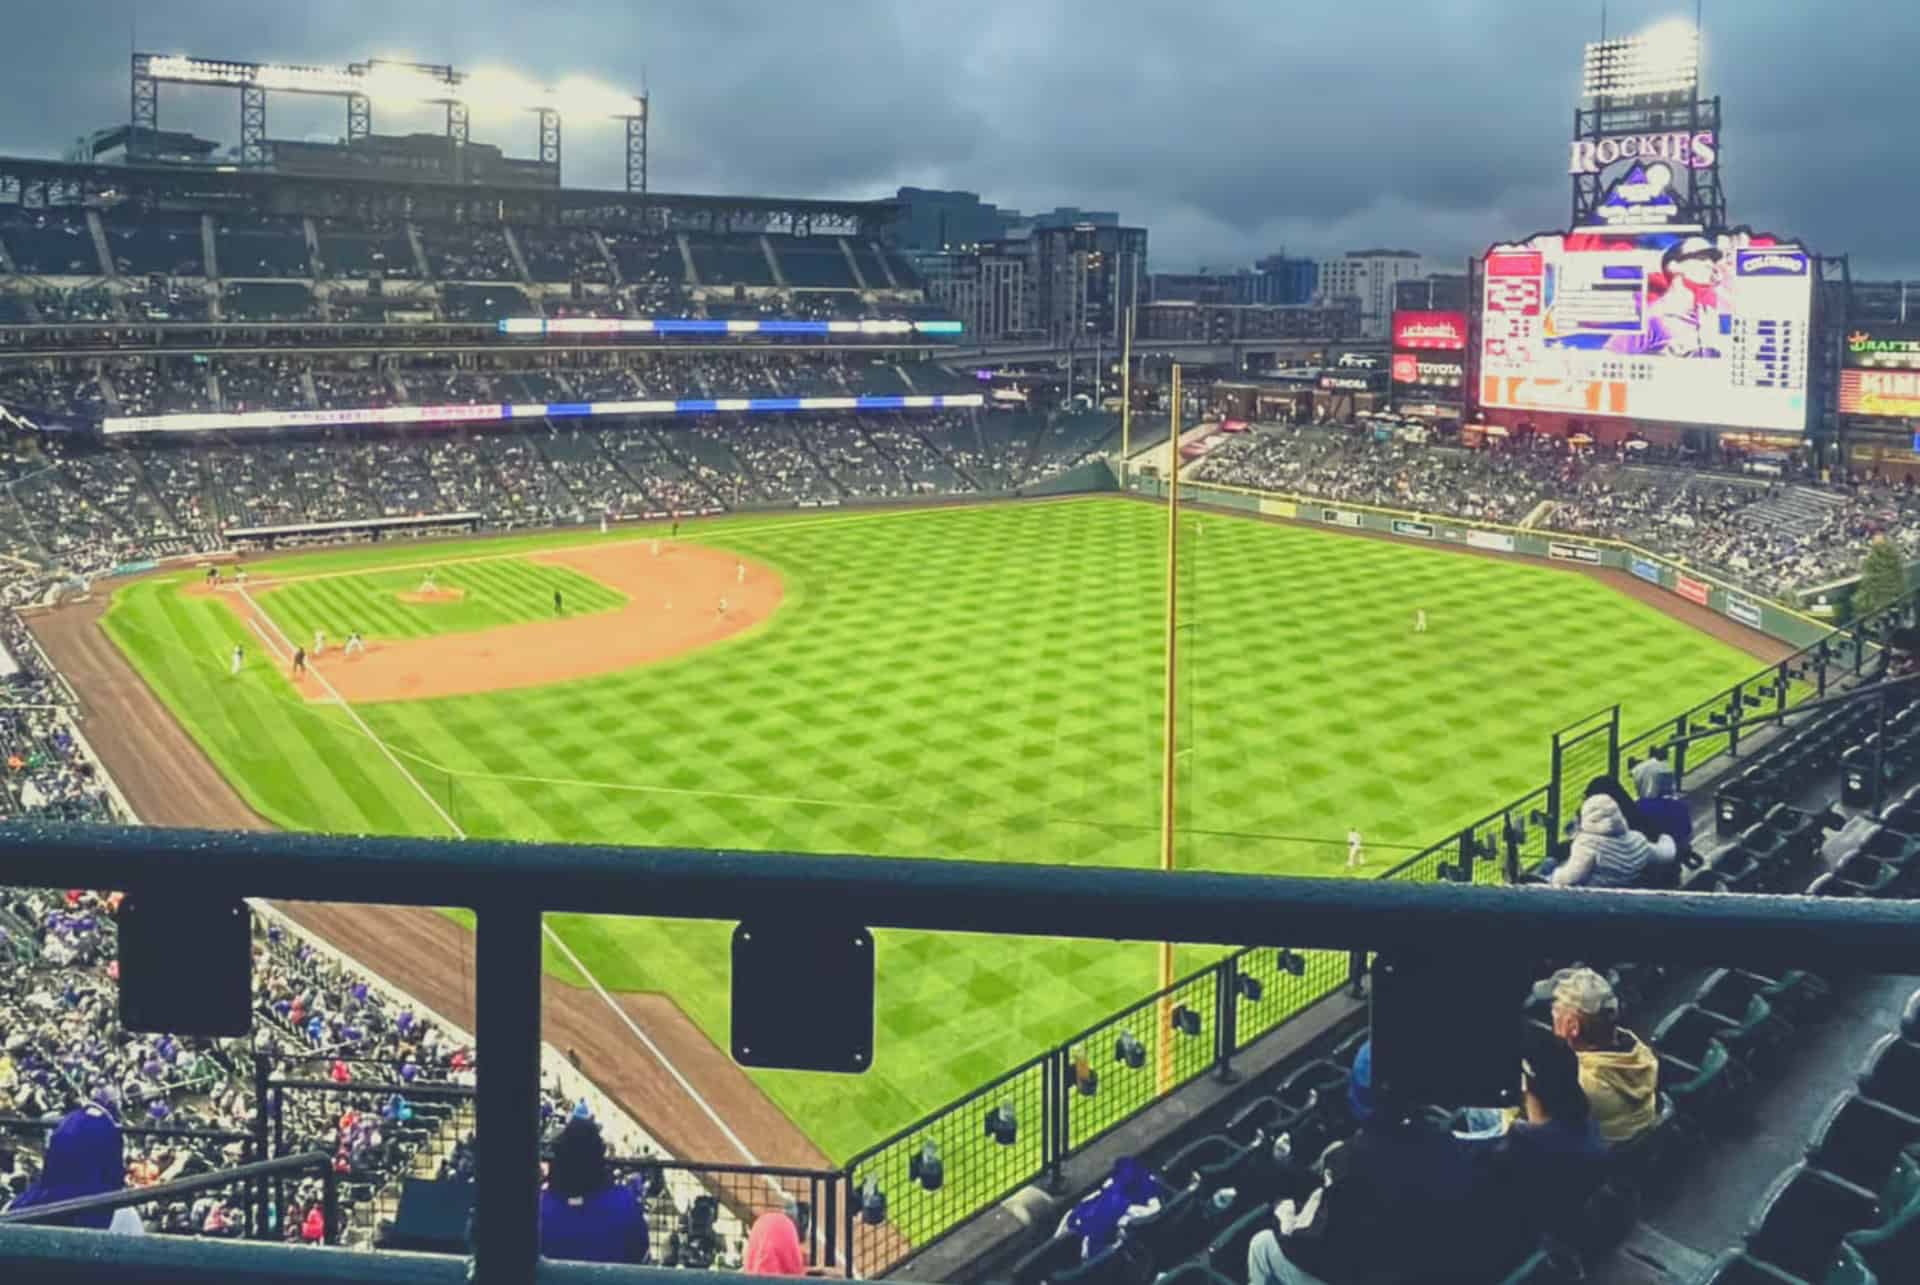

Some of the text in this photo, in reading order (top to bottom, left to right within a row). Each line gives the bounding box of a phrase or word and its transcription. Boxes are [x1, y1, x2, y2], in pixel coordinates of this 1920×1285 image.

[1568, 131, 1715, 174] ROCKIES
[1416, 363, 1462, 376] TOYOTA
[1861, 373, 1920, 395] KIN
